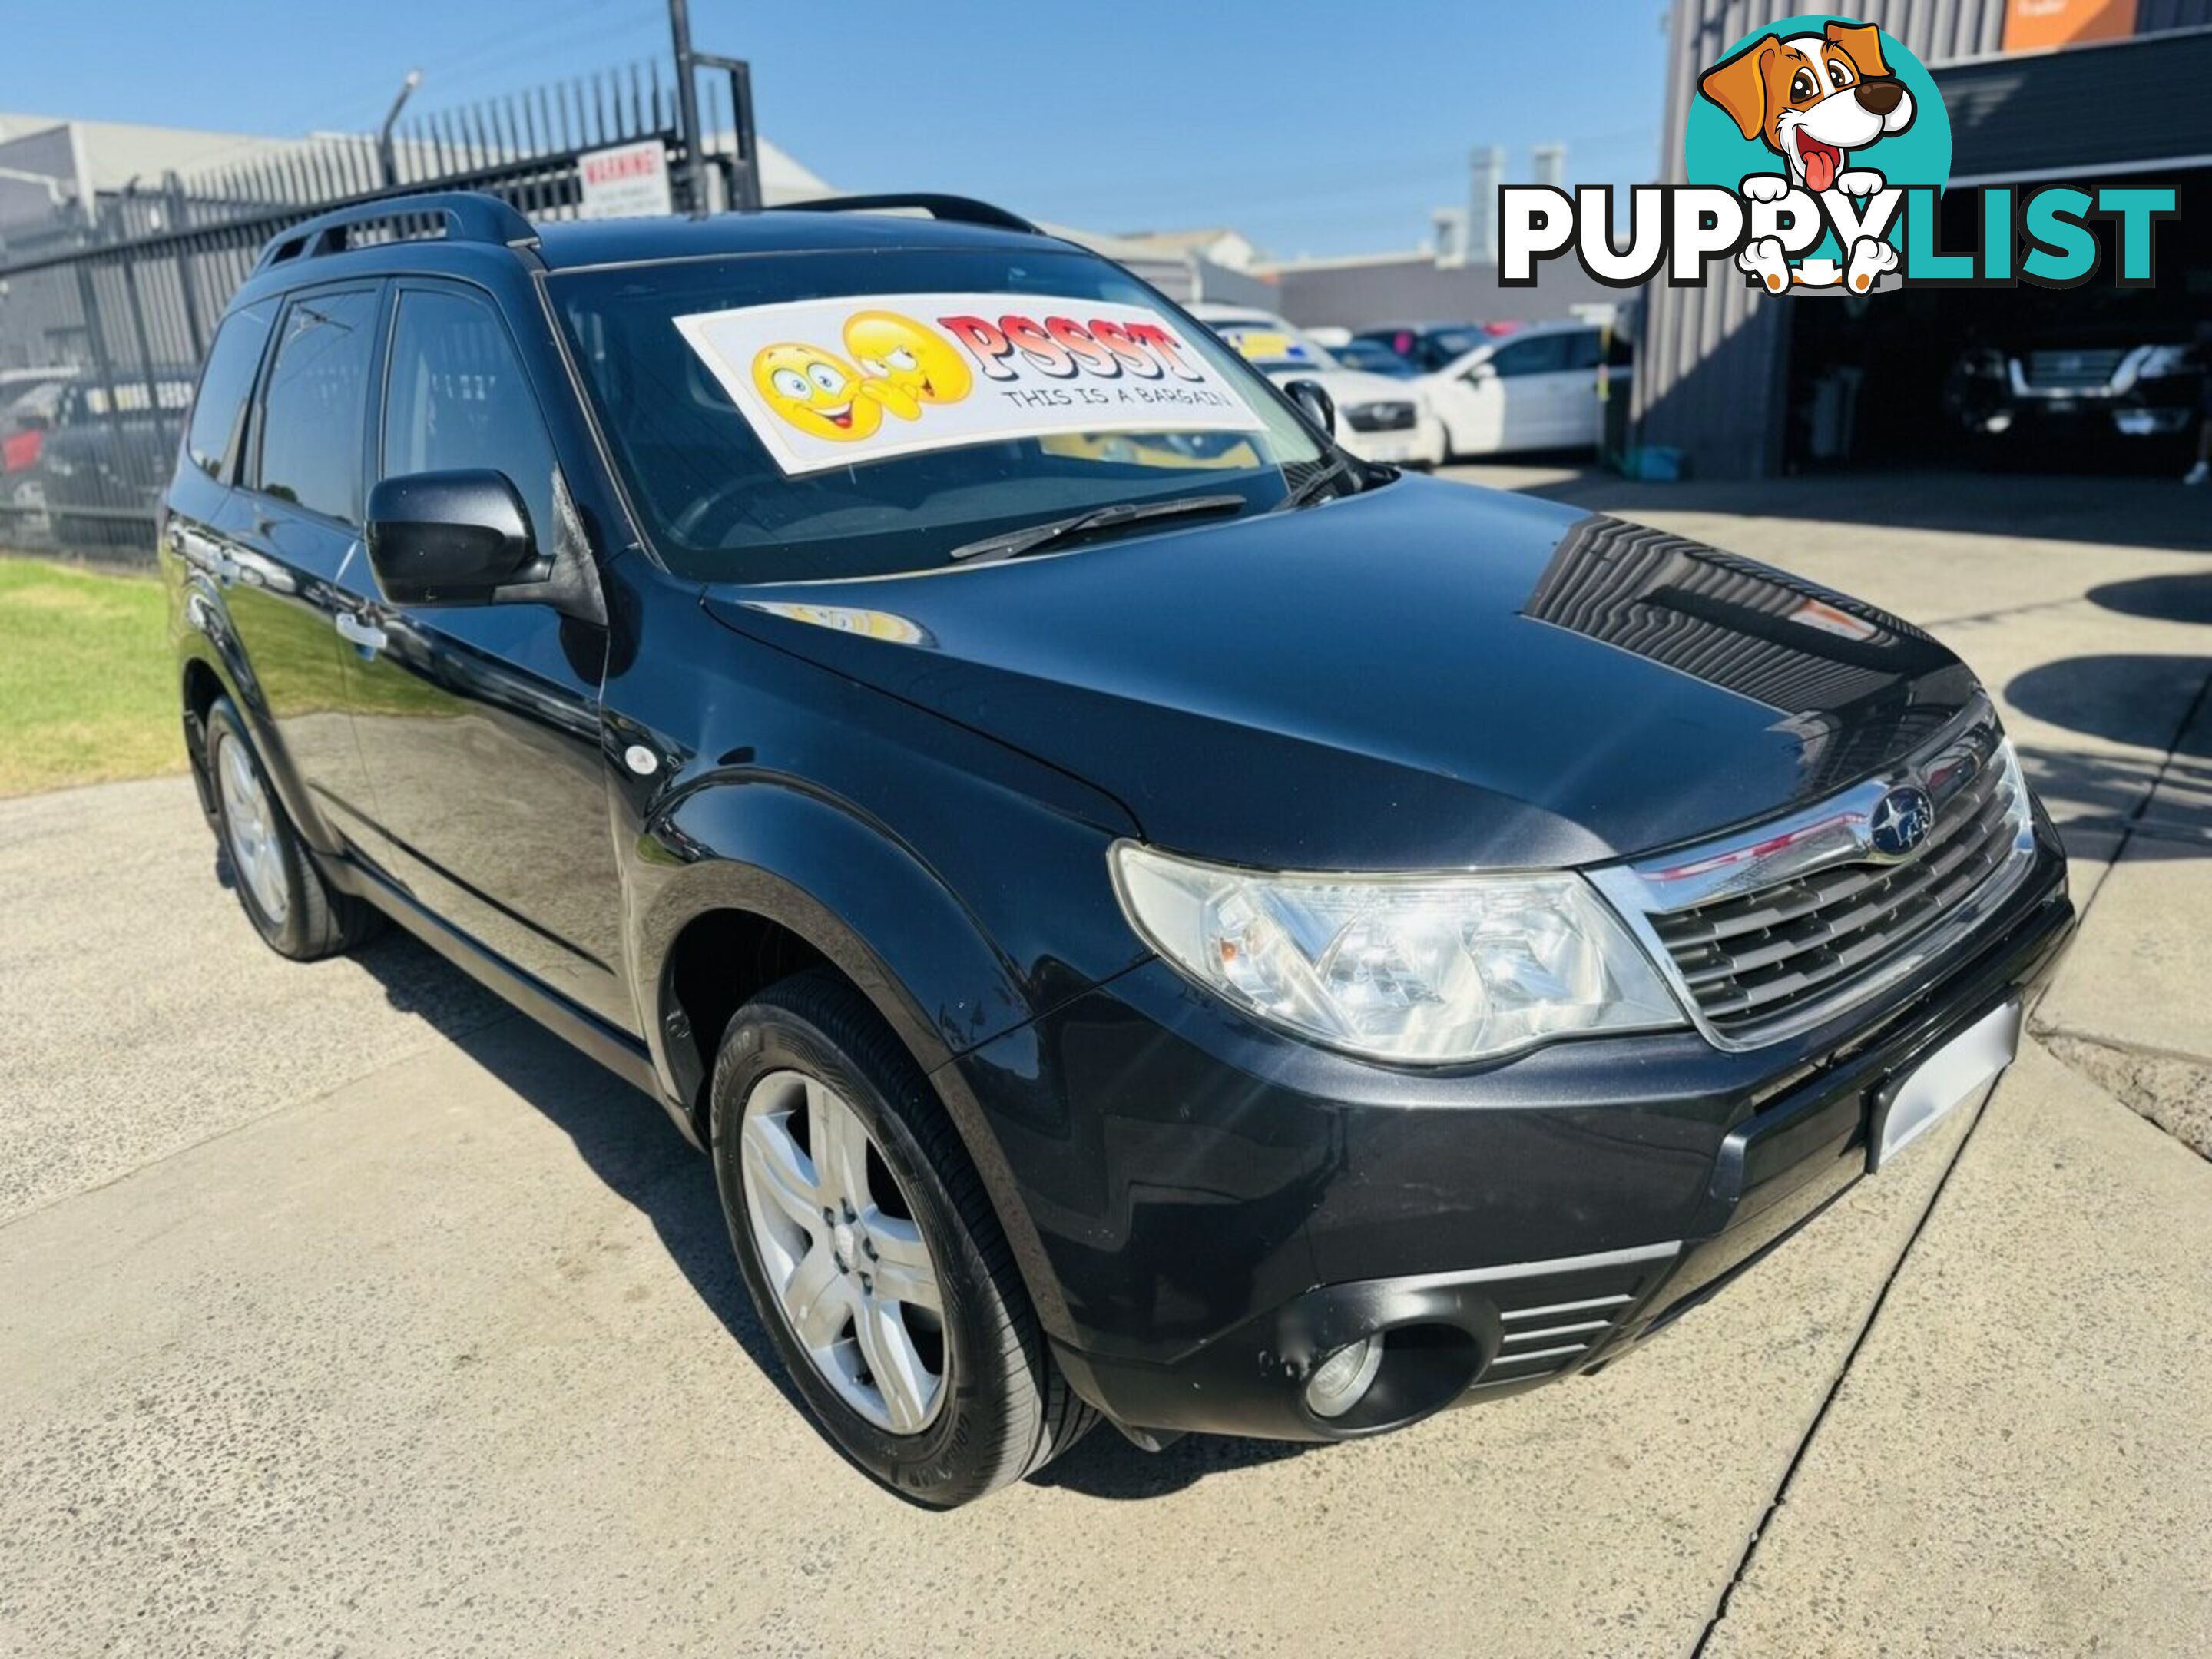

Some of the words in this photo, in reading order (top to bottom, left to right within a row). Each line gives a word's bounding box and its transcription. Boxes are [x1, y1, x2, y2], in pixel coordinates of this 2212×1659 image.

[937, 316, 1204, 382] PSSST
[1001, 390, 1072, 409] THIS
[1075, 389, 1108, 405] IS
[1118, 389, 1133, 402] A
[1134, 388, 1231, 409] BARGAIN
